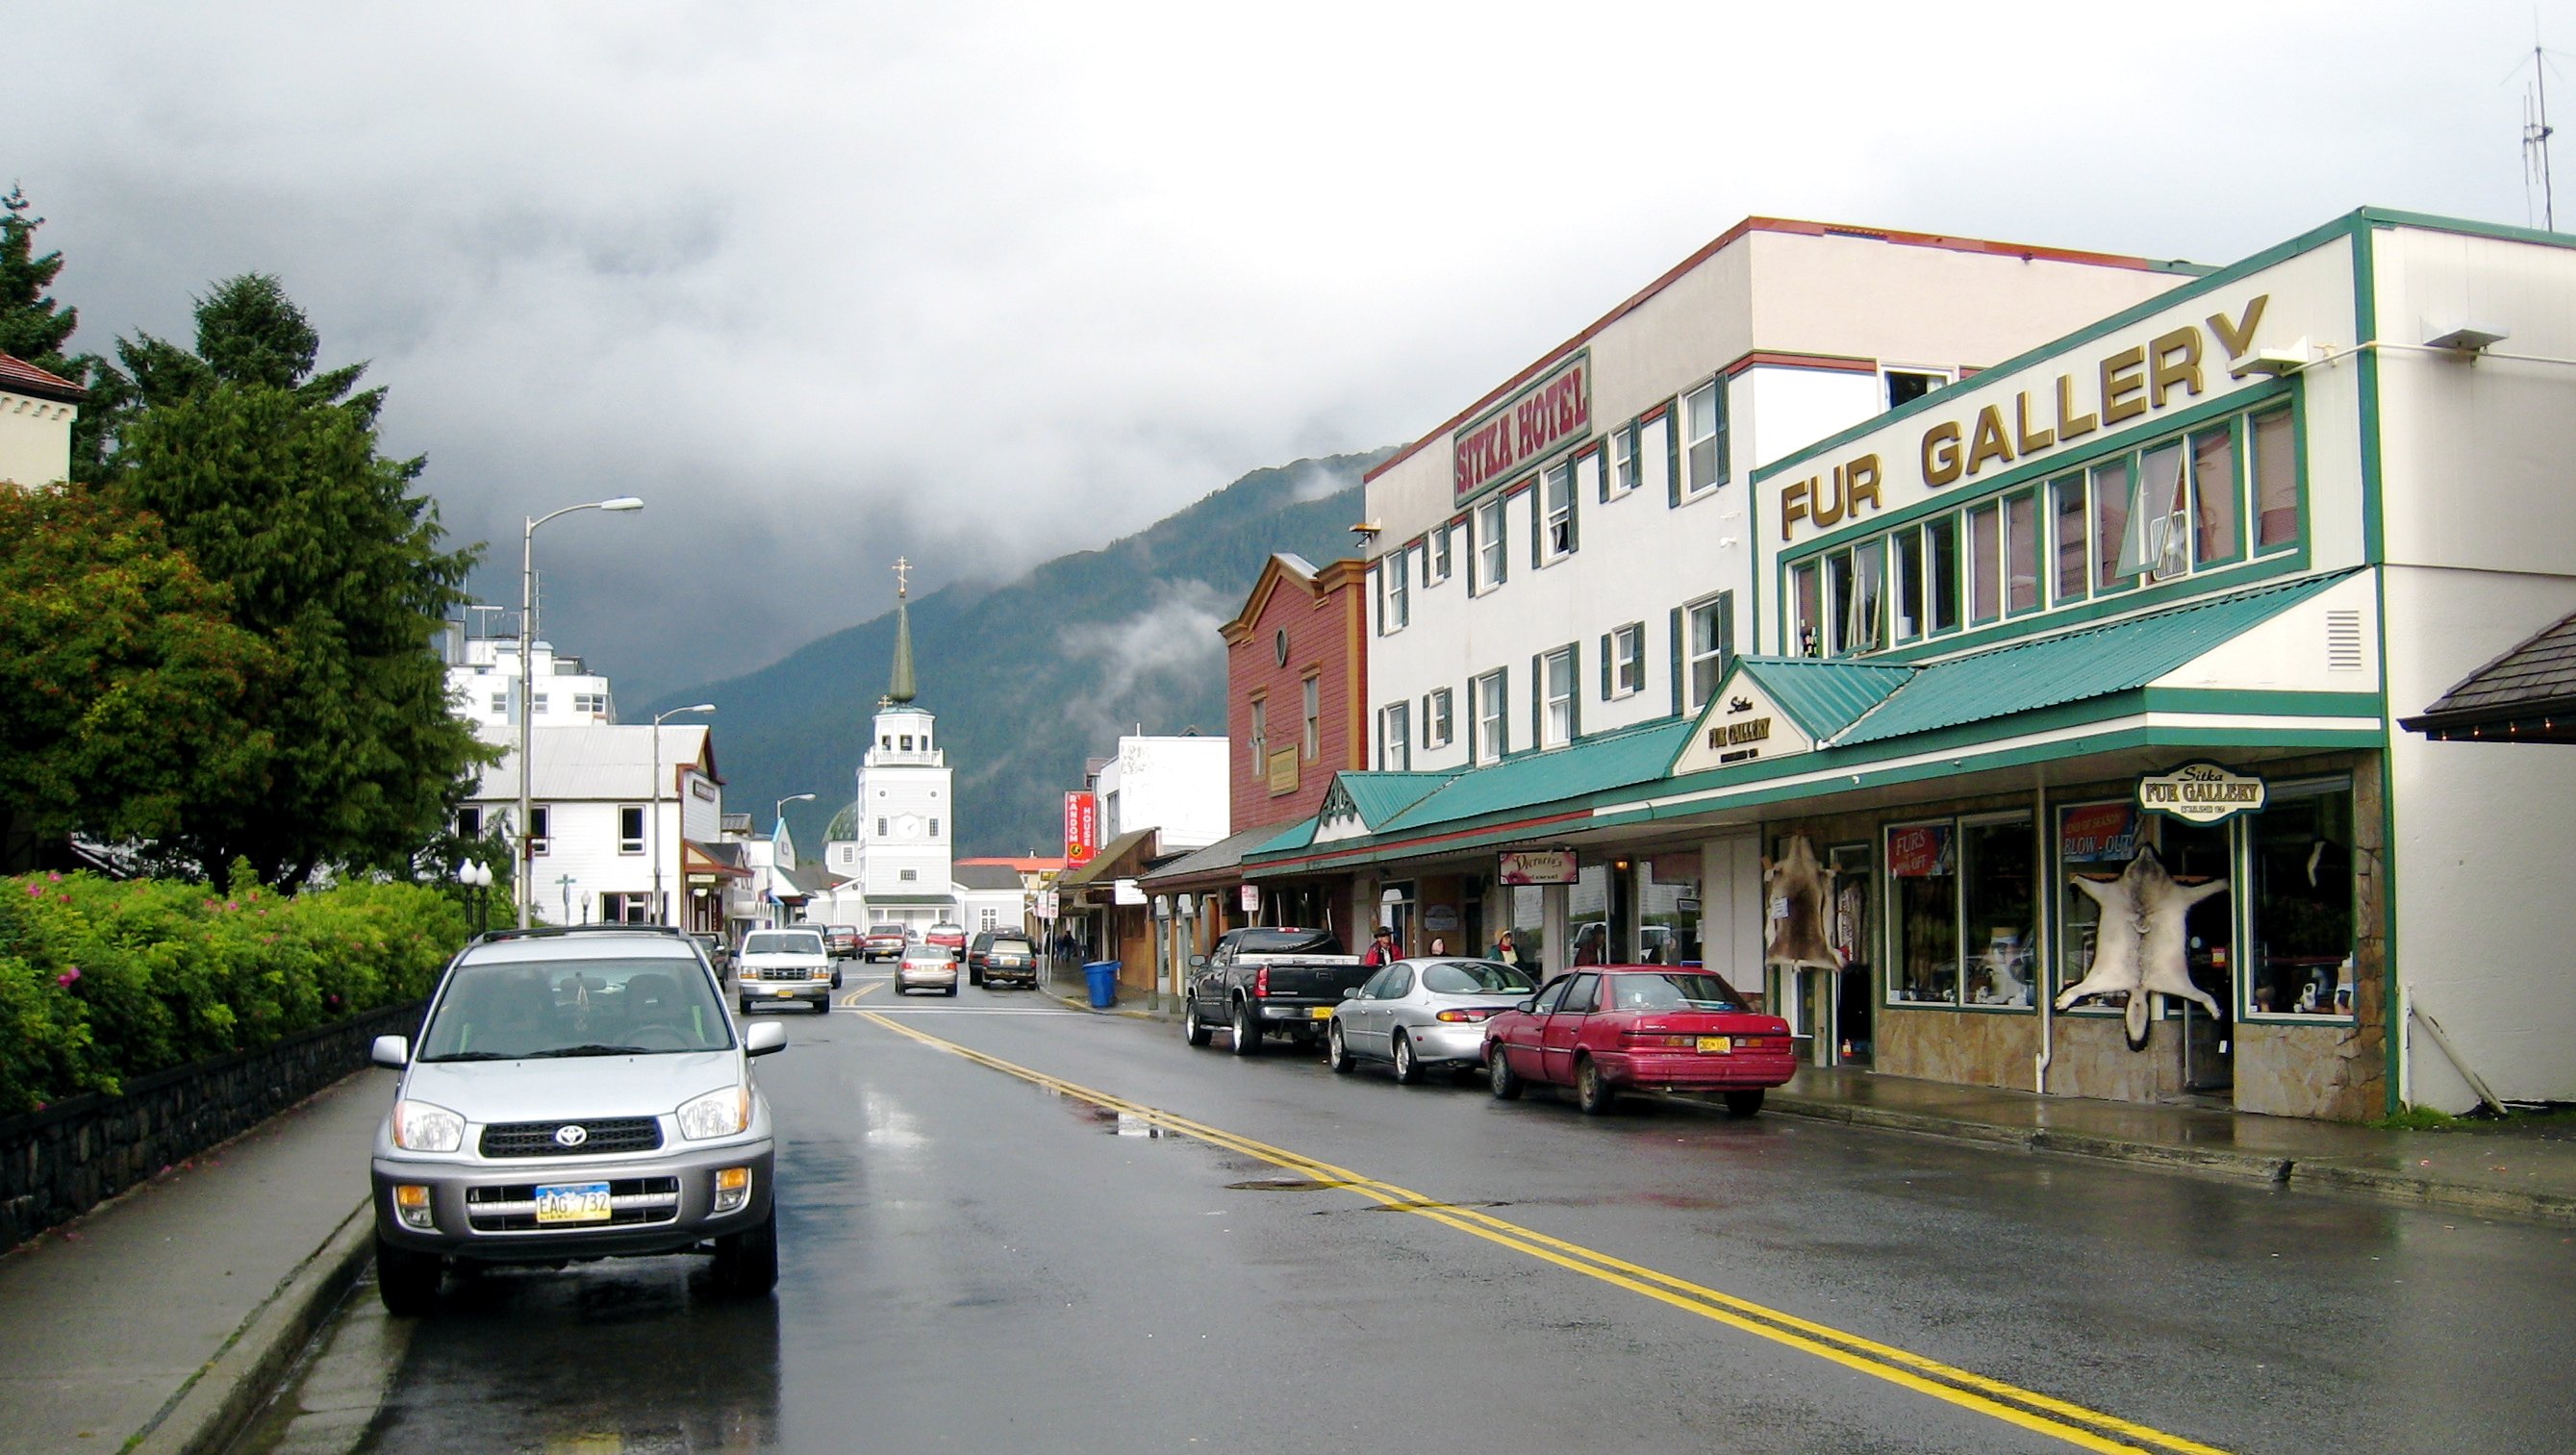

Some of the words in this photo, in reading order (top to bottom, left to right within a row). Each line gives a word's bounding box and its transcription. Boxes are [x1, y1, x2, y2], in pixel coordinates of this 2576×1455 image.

[1457, 414, 1513, 494] SITKA
[1518, 366, 1587, 460] HOTEL
[1781, 453, 1882, 540] FUR
[1922, 294, 2269, 488] GALLERY
[1708, 727, 1728, 749] FUR
[1729, 717, 1771, 745] GALLERY
[2178, 766, 2223, 782] Sitka
[2145, 784, 2180, 803] FUR
[2183, 783, 2260, 803] GALLERY
[1070, 795, 1078, 842] RANDOM
[1083, 807, 1092, 846] HOUSE
[1896, 829, 1925, 856] FURS
[2064, 837, 2097, 855] BLOW
[2106, 835, 2133, 853] OUT
[540, 1196, 568, 1215] EAG
[580, 1193, 607, 1213] 732
